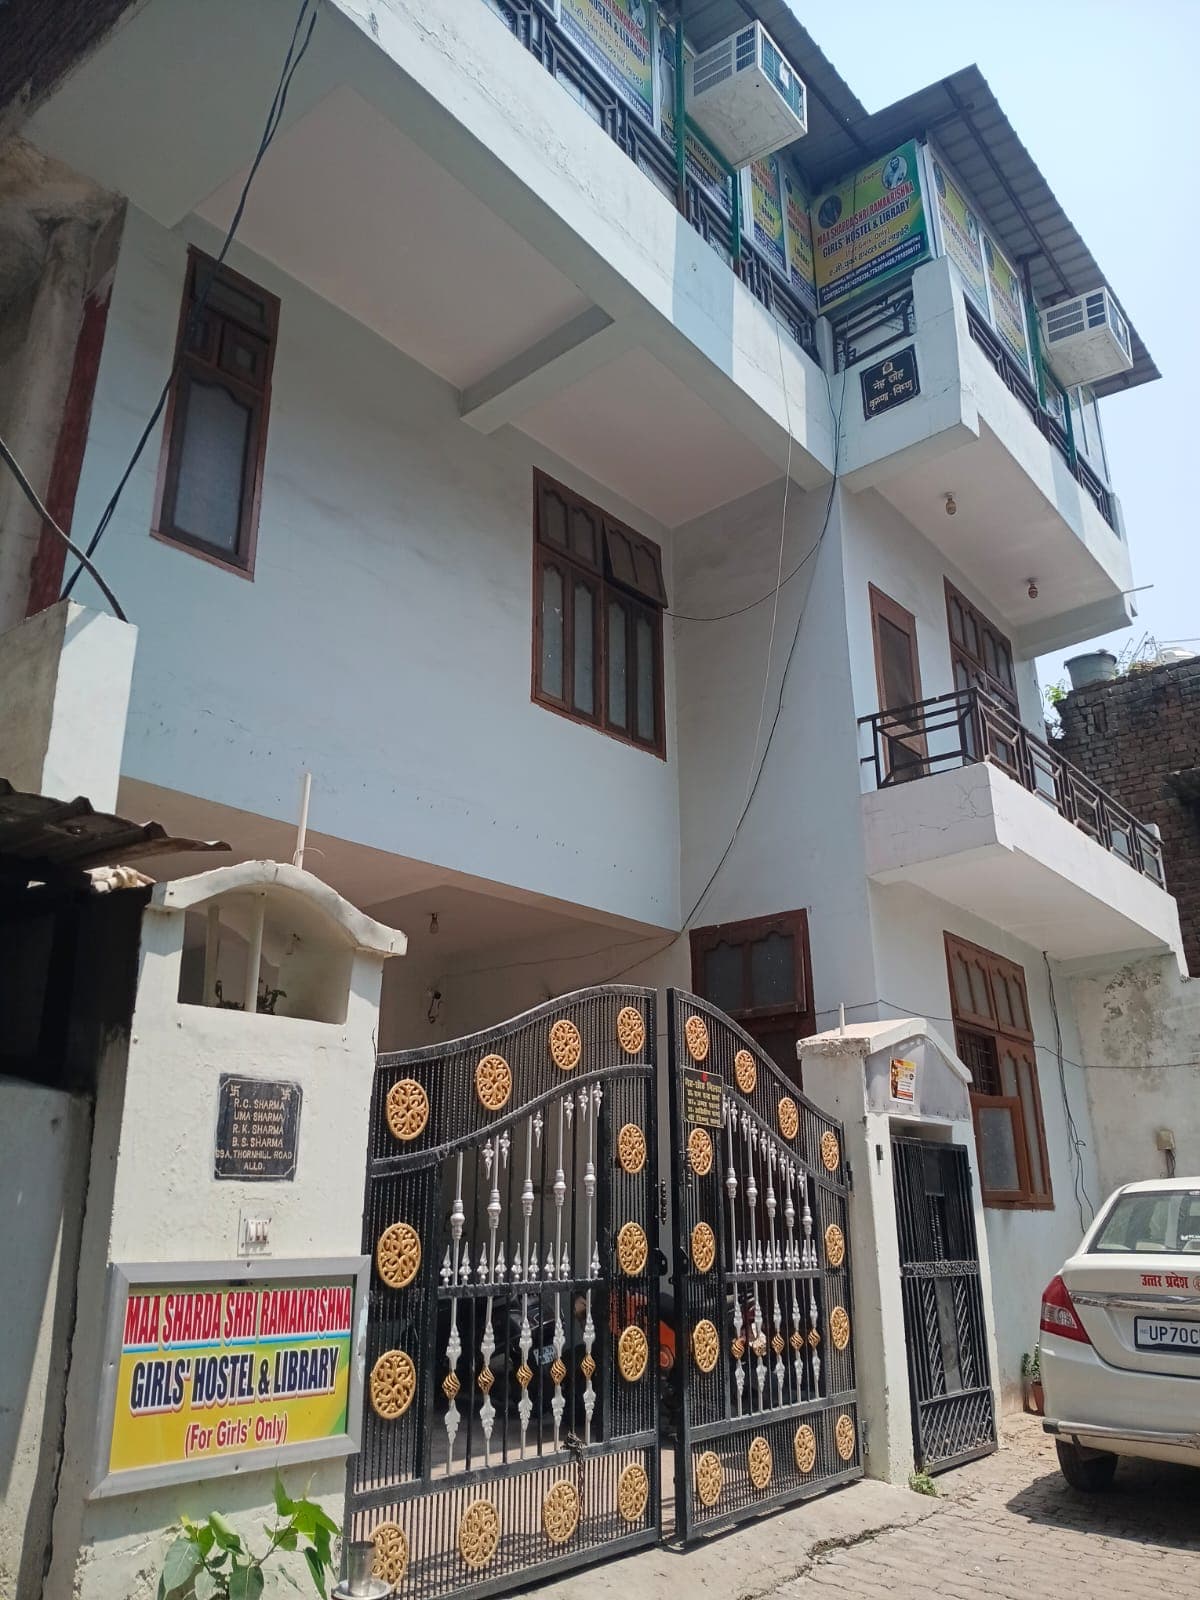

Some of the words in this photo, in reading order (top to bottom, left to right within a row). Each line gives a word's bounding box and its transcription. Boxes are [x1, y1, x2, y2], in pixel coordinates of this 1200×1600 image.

[845, 221, 872, 246] HOSTEL
[879, 198, 911, 225] LIBRARY
[253, 1099, 286, 1110] SHARMA
[233, 1109, 251, 1121] UMA
[252, 1111, 285, 1122] SHARMA
[251, 1124, 284, 1135] SHARMA
[250, 1137, 284, 1148] SHARMA
[273, 1150, 293, 1160] ROAD
[1140, 1274, 1162, 1287] उत्तर
[1164, 1271, 1189, 1289] प्रदेश
[123, 1295, 161, 1345] MAA
[162, 1291, 223, 1344] SHARDA
[223, 1289, 259, 1340] SHRI
[259, 1287, 352, 1336] RAMAKRISHNA
[1149, 1325, 1200, 1345] UP70C
[130, 1359, 191, 1411] GIRLS'
[192, 1353, 255, 1403] HOSTEL
[257, 1358, 271, 1396] &
[273, 1346, 340, 1394] LIBRARY
[183, 1422, 213, 1458] (For
[216, 1417, 253, 1447] Girls'
[254, 1412, 289, 1446] Only)
